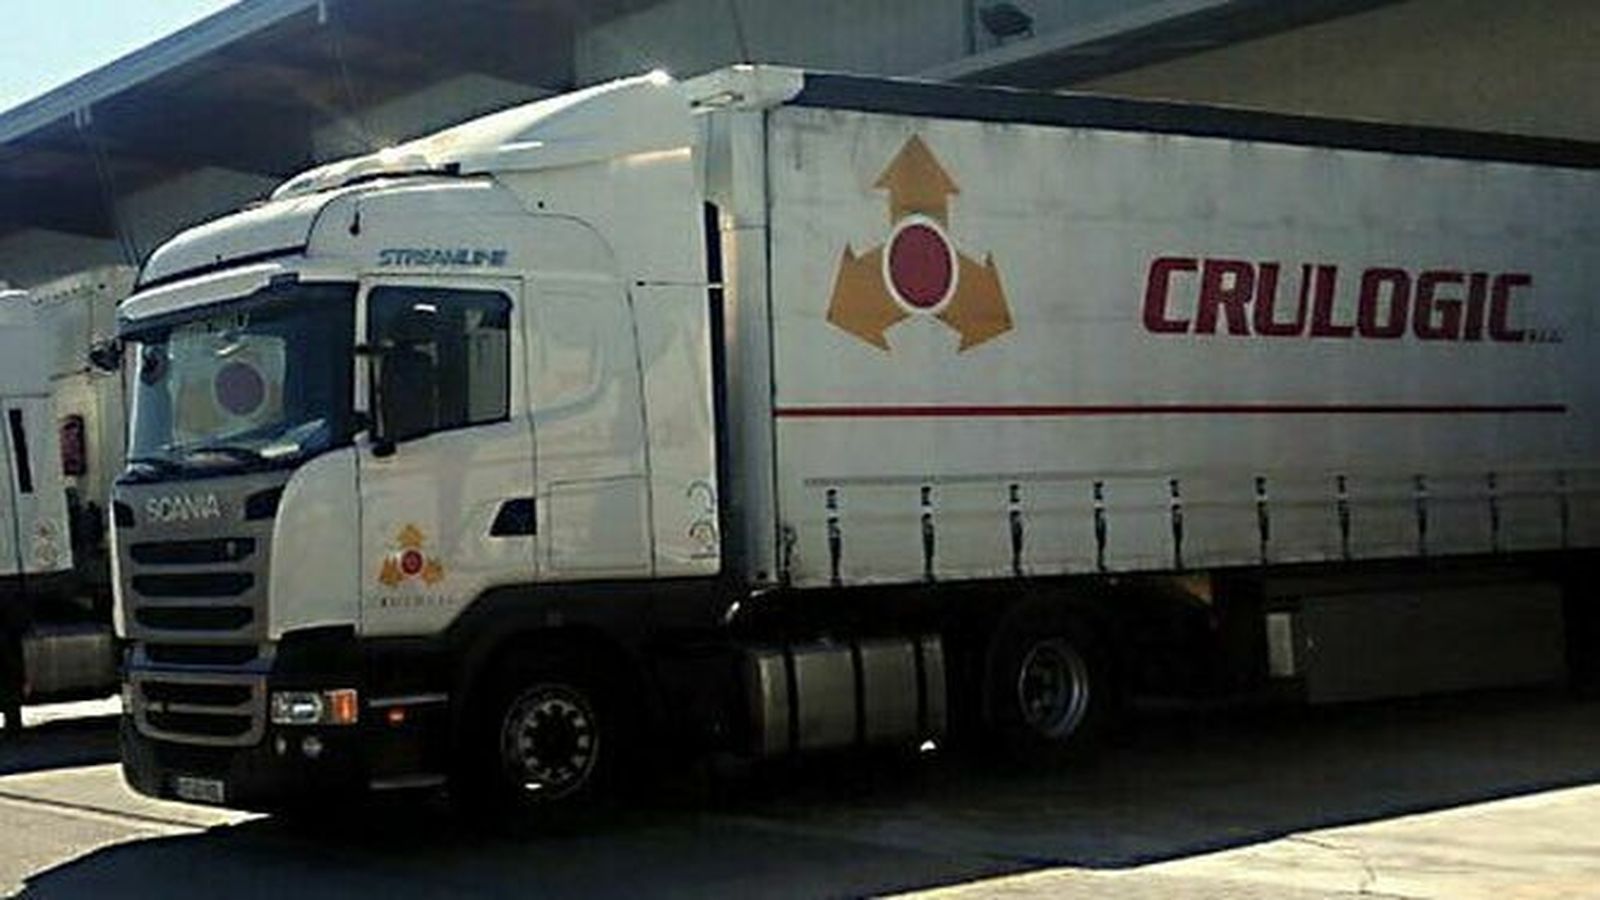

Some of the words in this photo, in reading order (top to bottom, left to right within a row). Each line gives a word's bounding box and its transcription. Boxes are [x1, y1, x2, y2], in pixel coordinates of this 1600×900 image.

[378, 249, 508, 267] STREAMLINE
[1144, 257, 1533, 343] CRULOGIC
[146, 494, 221, 522] SCANIA
